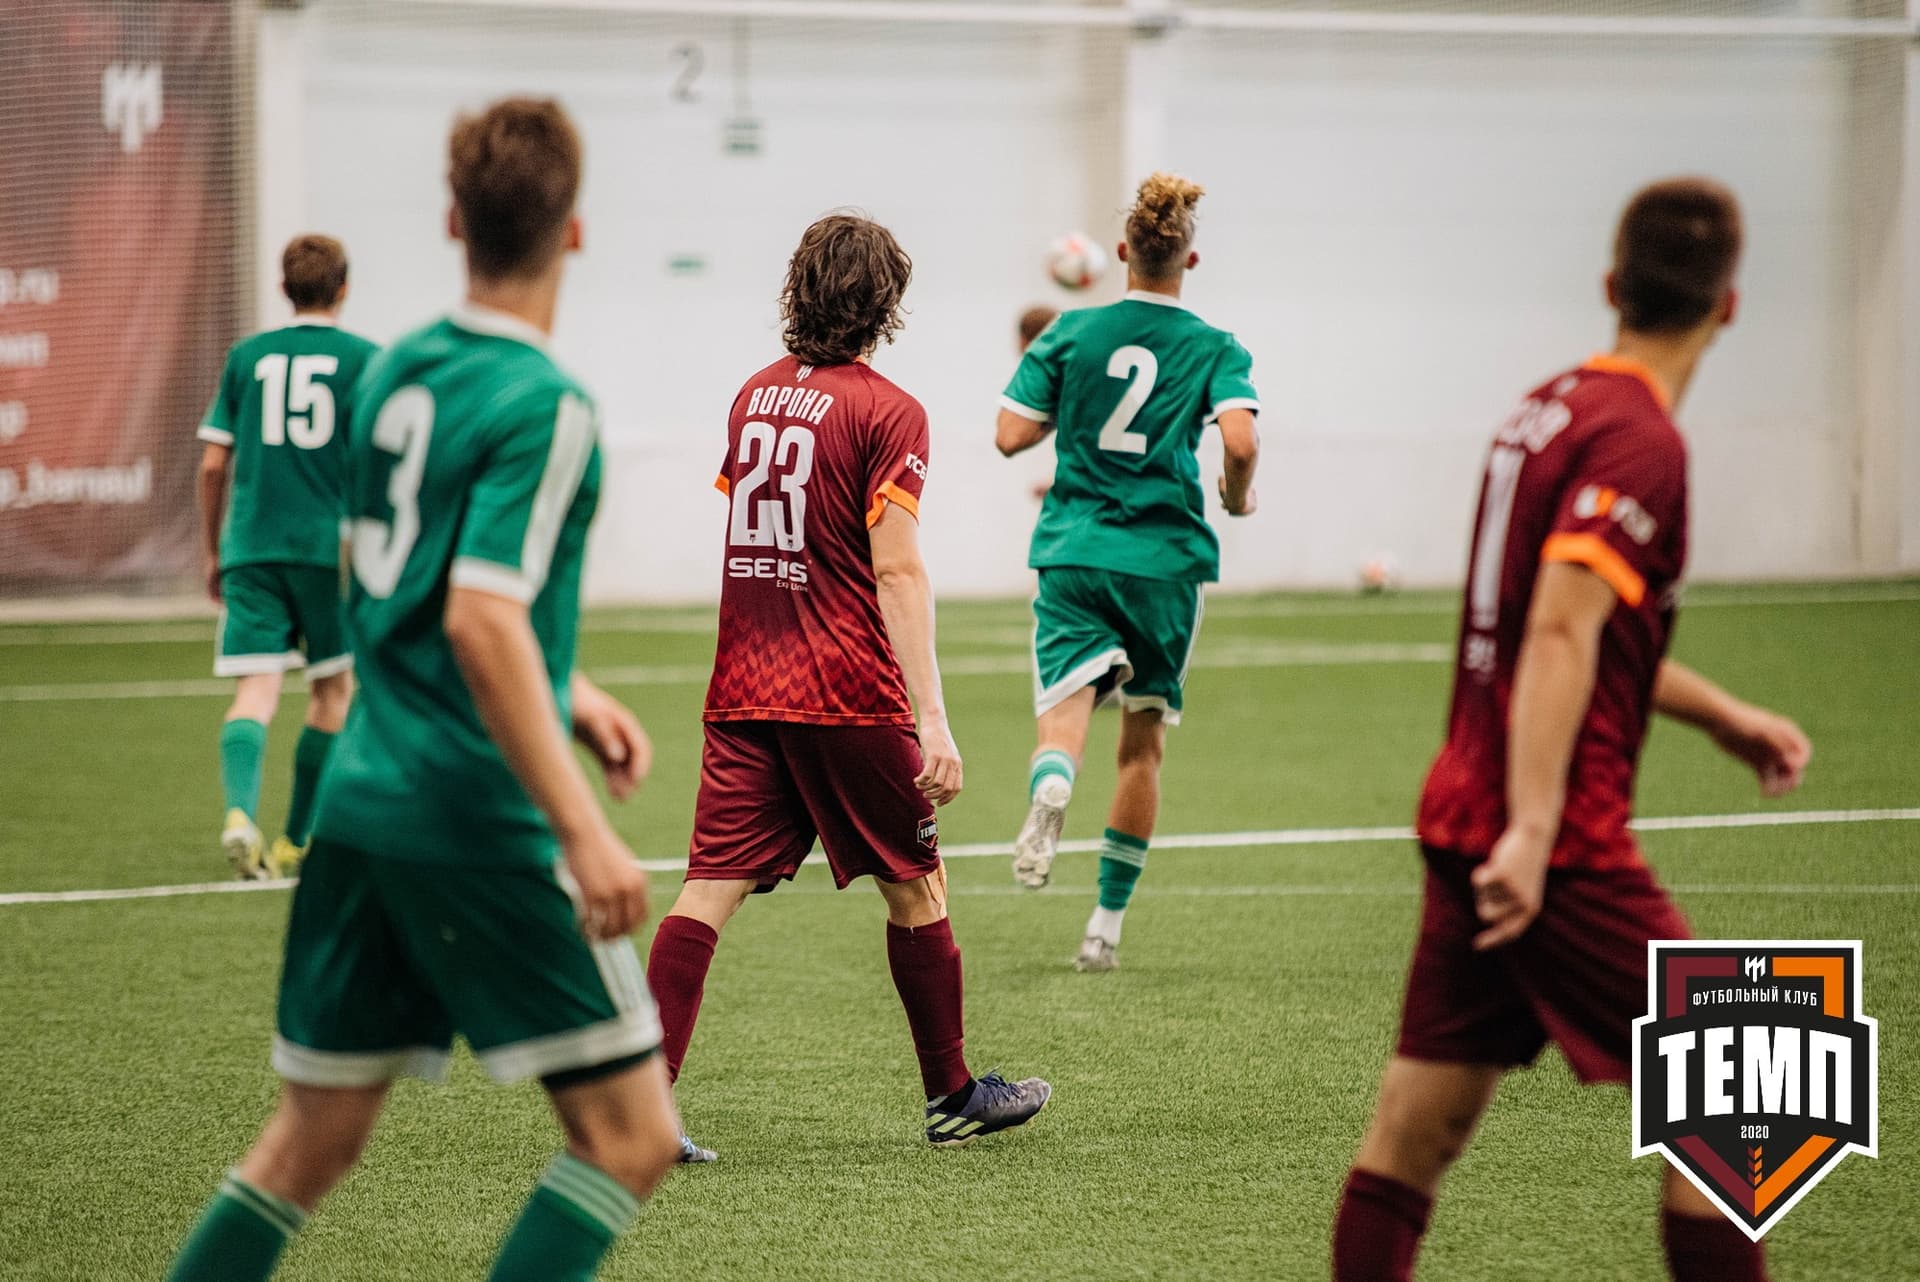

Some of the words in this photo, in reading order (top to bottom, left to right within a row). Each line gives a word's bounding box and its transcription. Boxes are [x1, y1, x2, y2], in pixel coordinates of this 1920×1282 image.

[669, 44, 705, 102] 2
[254, 353, 339, 450] 15
[746, 385, 834, 425] ВОРОНА
[1098, 344, 1159, 455] 2
[353, 384, 436, 599] 3
[729, 421, 815, 552] 23
